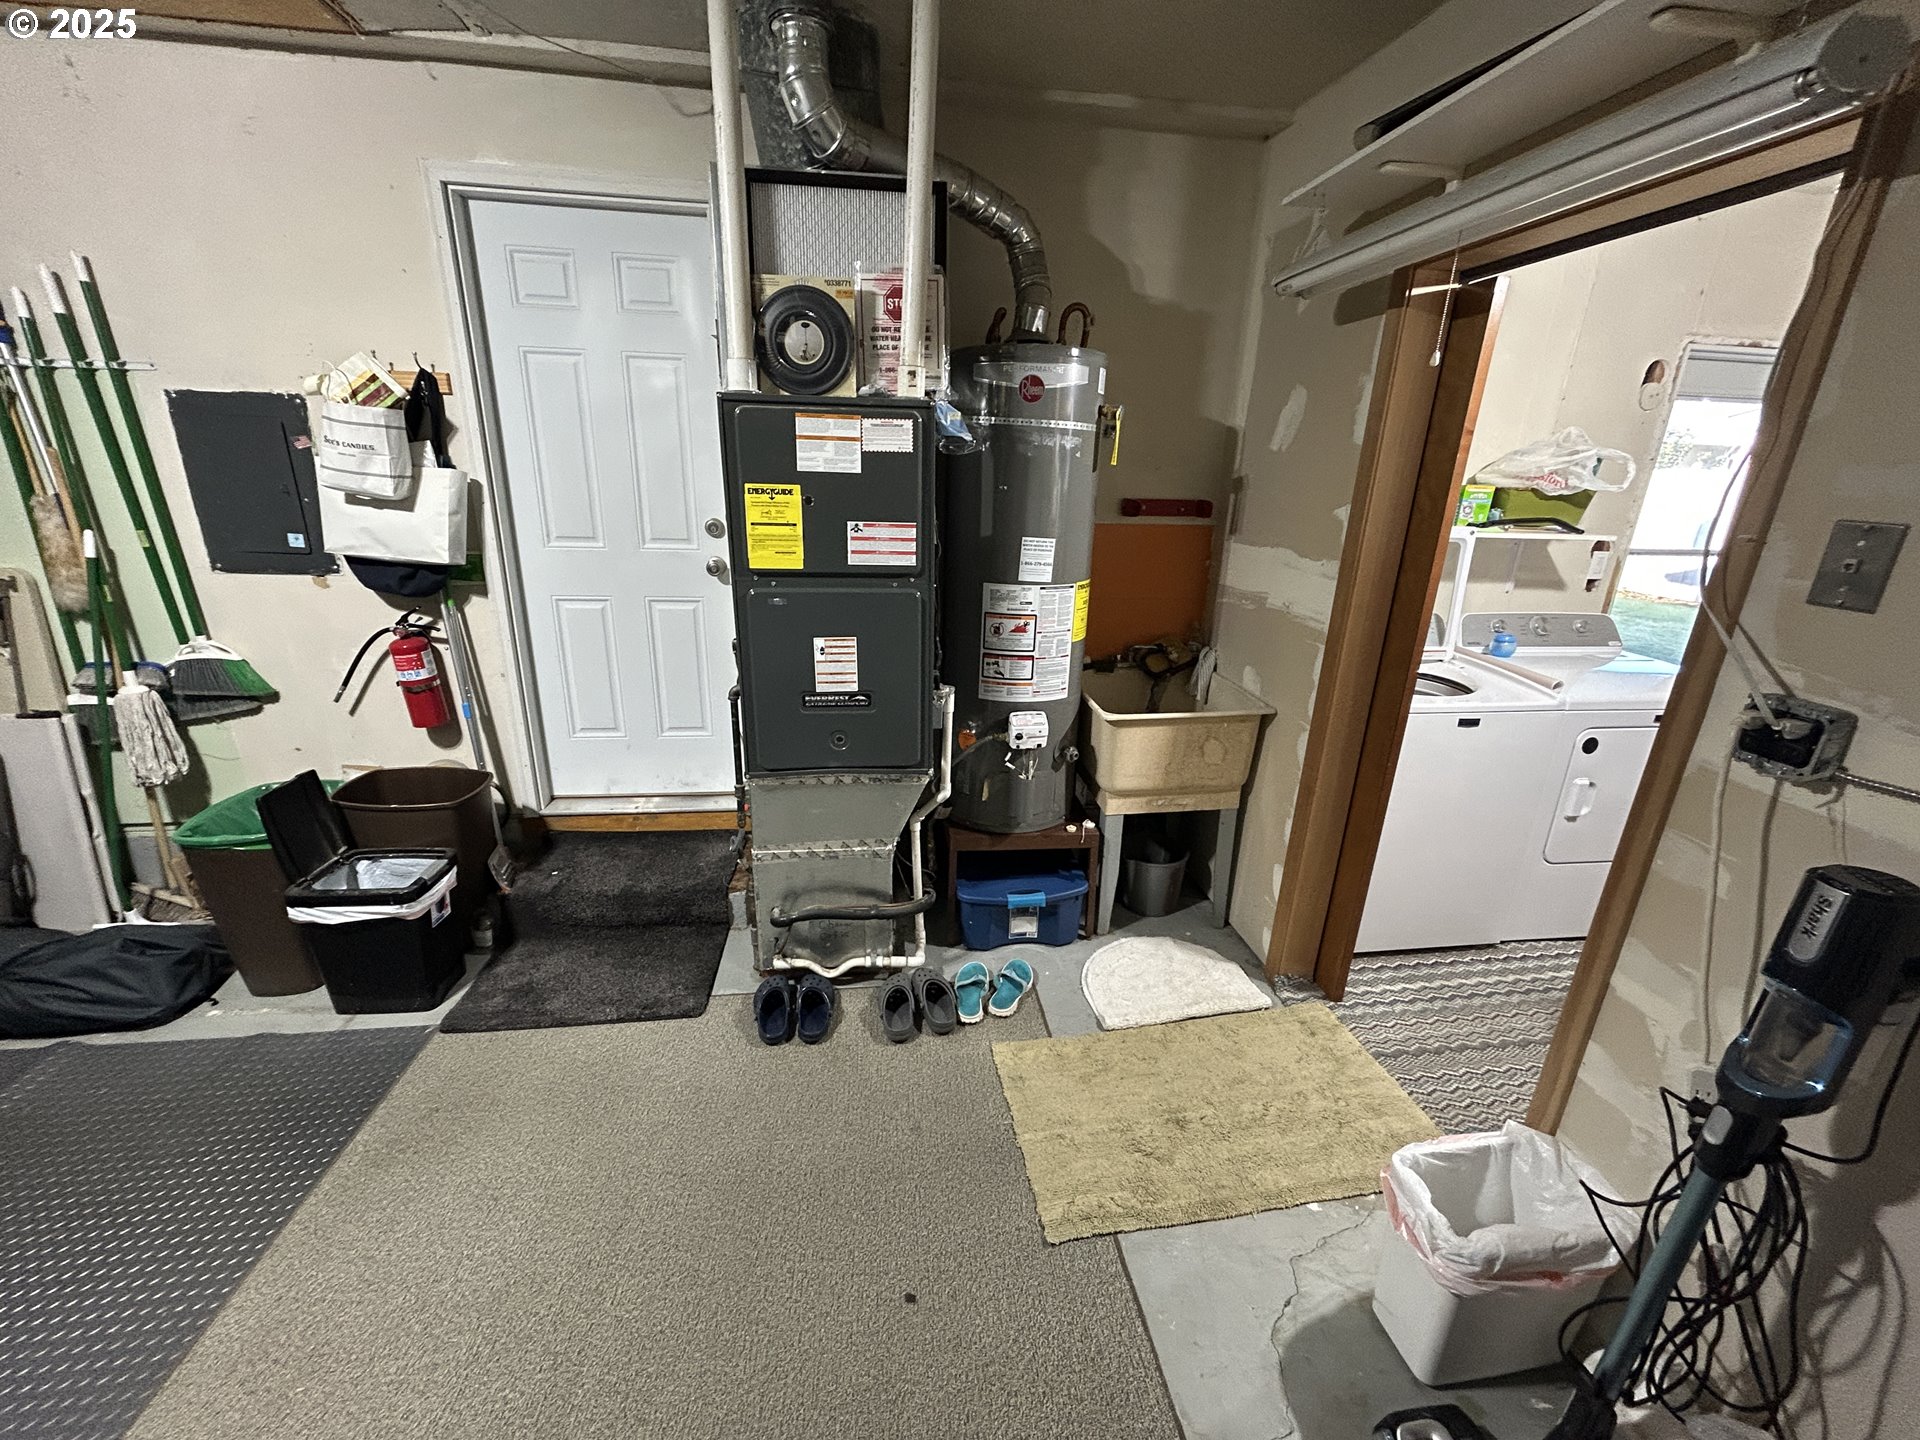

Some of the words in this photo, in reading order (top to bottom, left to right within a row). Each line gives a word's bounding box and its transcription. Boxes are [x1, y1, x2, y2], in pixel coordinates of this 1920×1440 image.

[887, 298, 903, 309] ST
[1021, 375, 1044, 399] Rheem
[342, 441, 375, 450] CANDIES
[1801, 895, 1833, 939] Shark
